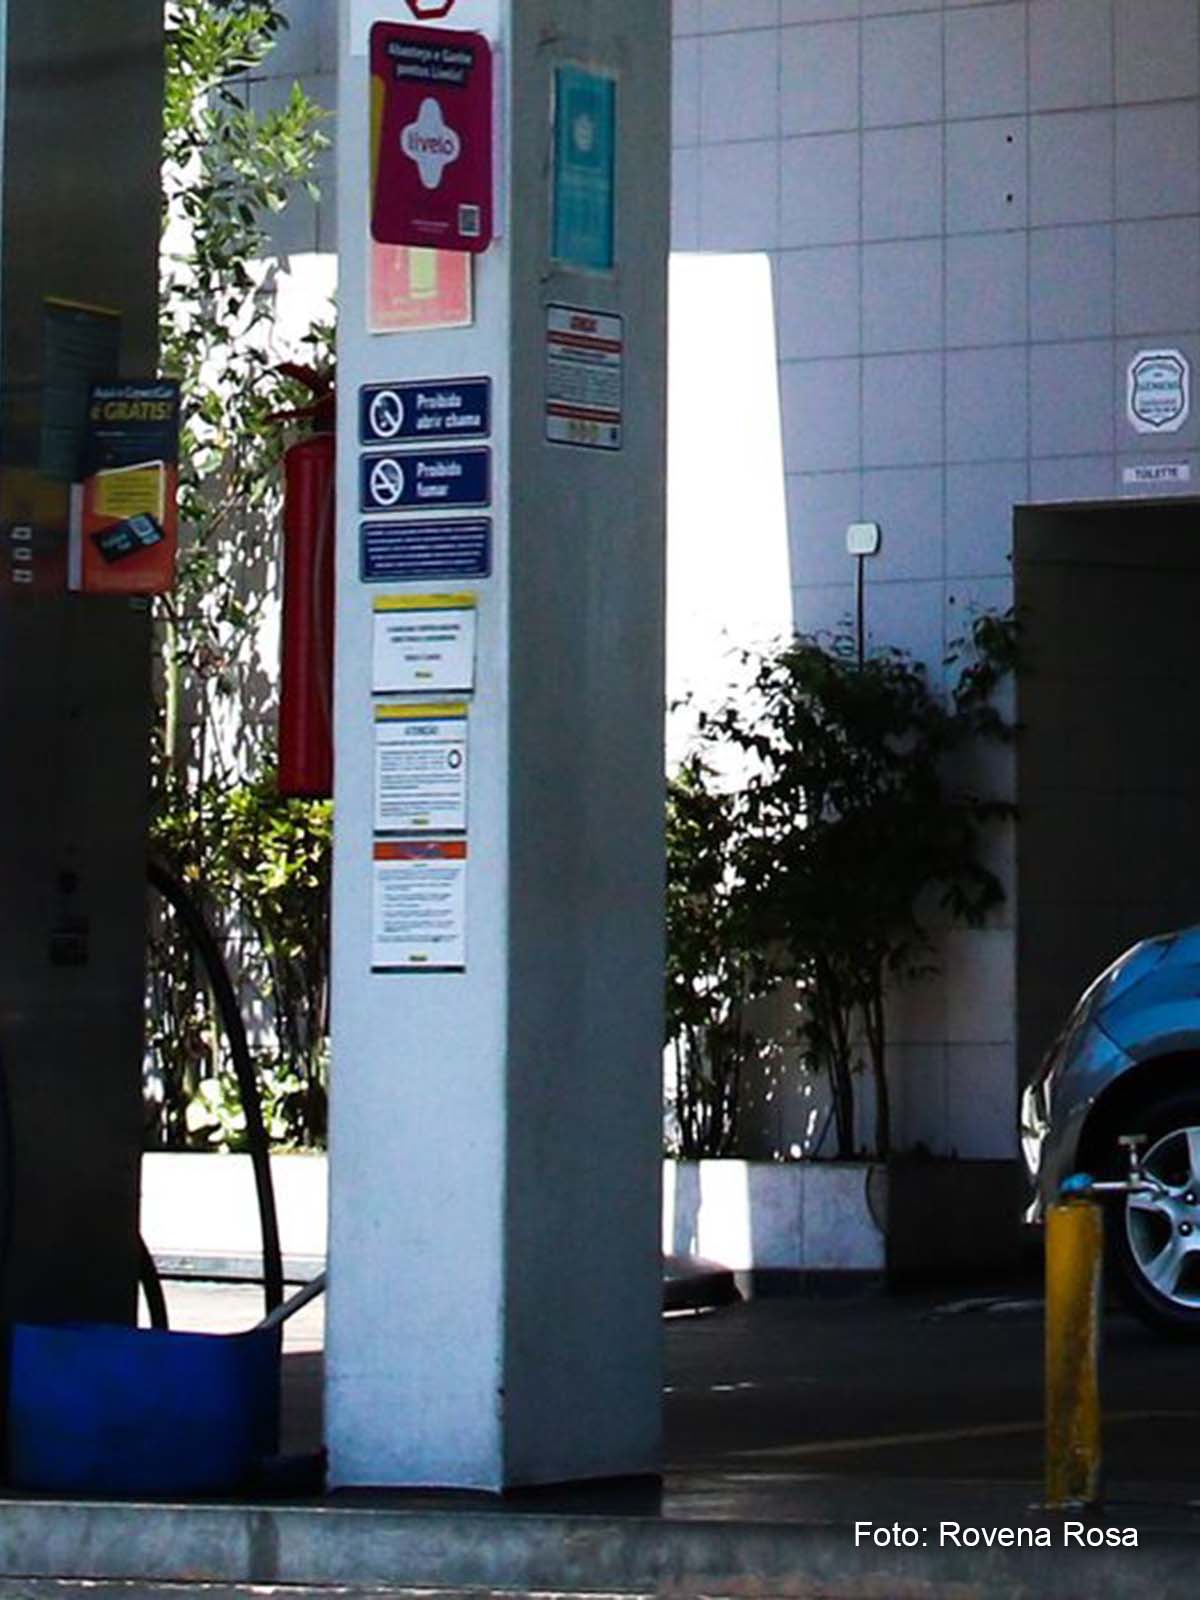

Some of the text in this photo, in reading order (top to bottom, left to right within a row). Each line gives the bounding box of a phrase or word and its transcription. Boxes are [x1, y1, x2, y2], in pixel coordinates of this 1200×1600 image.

[407, 133, 455, 155] livelo
[416, 393, 462, 410] Proibido
[445, 414, 481, 428] chama
[416, 461, 463, 478] Proibido
[416, 482, 449, 497] fumar
